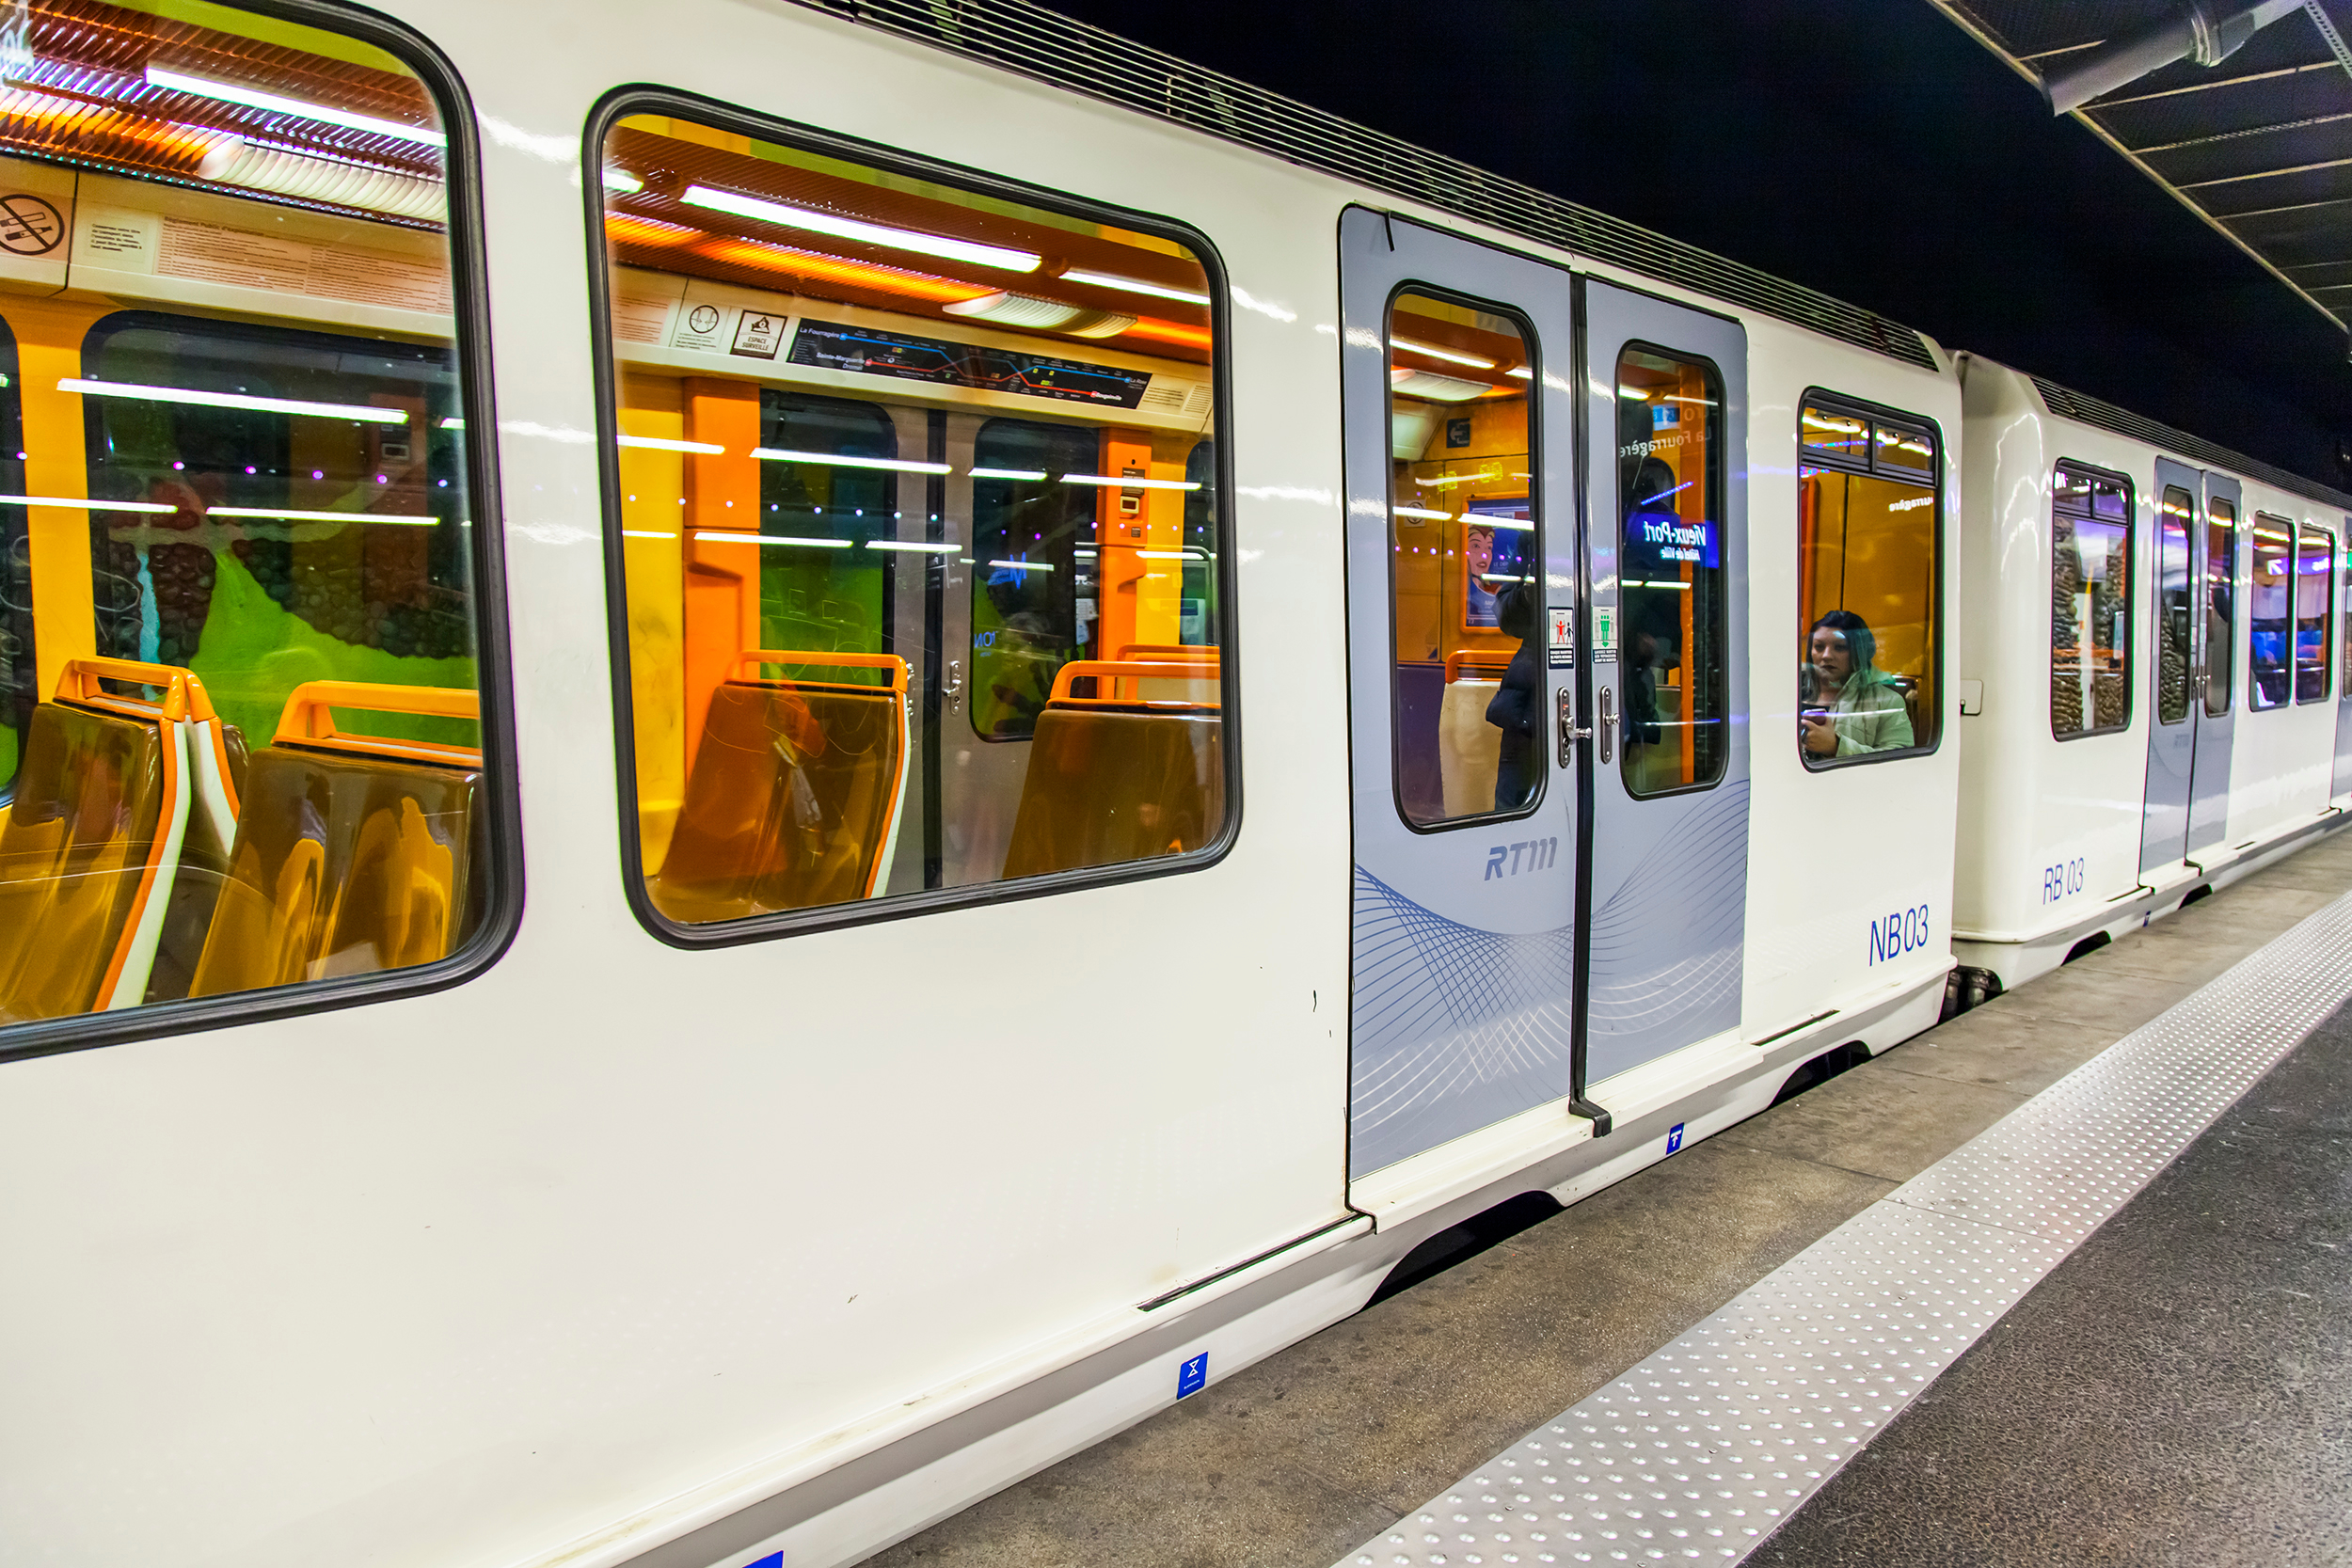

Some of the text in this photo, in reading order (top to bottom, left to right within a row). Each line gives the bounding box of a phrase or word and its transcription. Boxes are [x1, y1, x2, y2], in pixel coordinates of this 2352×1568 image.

[747, 336, 767, 344] ESPACE
[2043, 857, 2084, 905] RB 03
